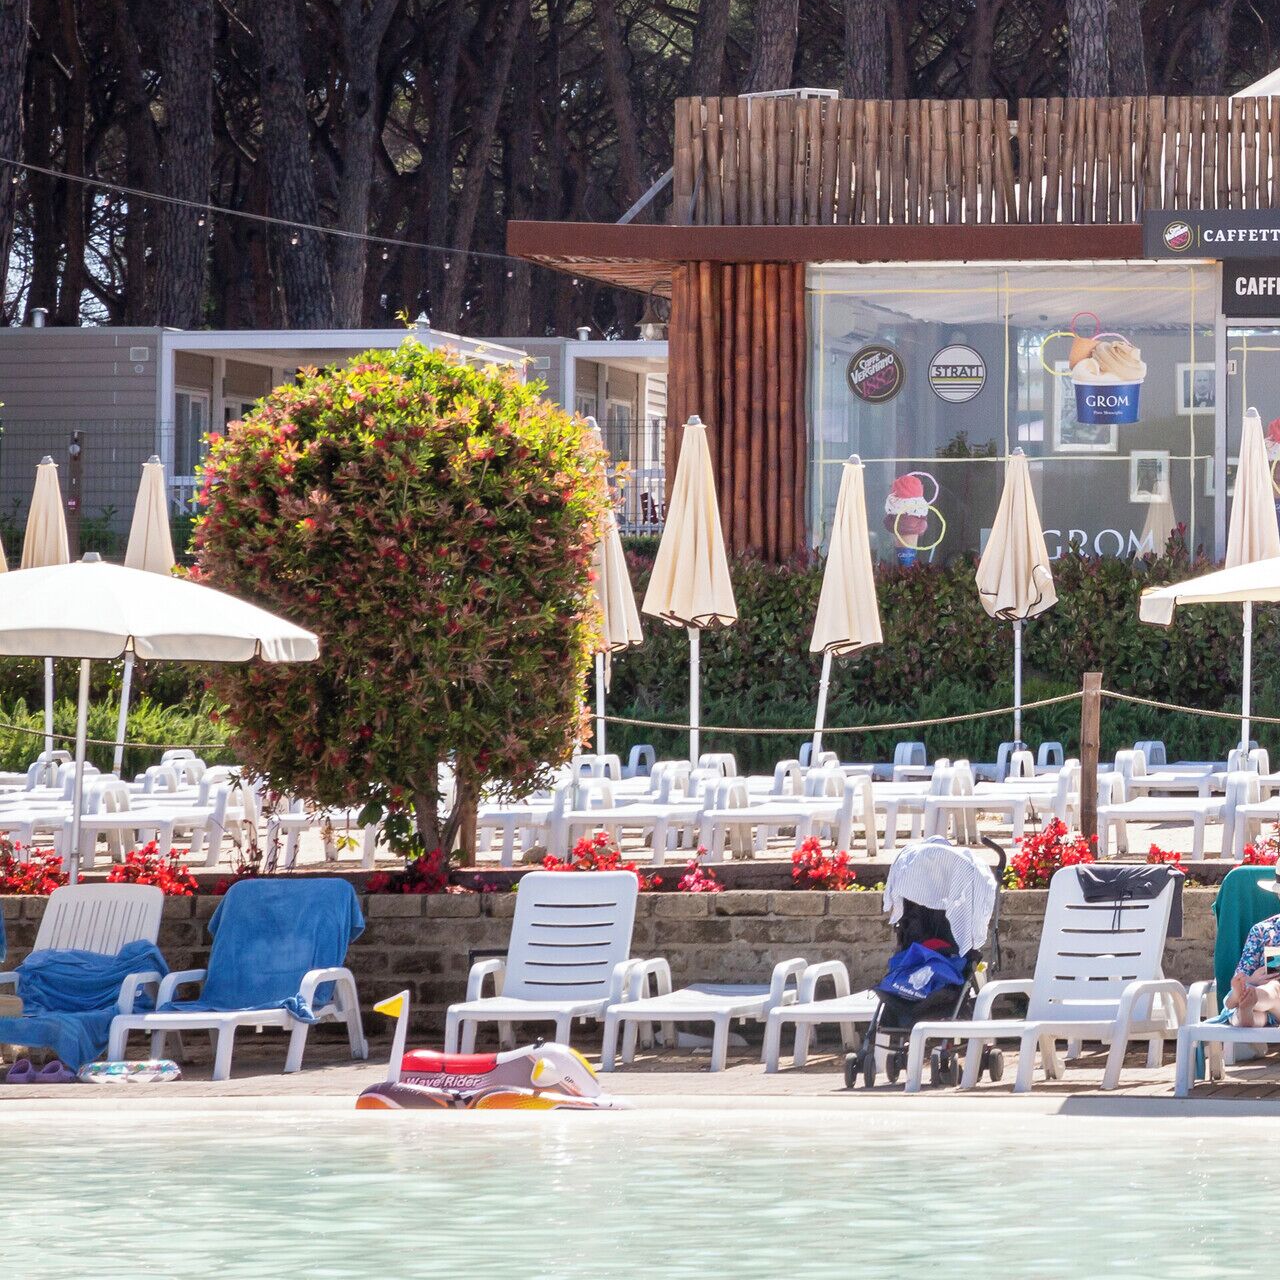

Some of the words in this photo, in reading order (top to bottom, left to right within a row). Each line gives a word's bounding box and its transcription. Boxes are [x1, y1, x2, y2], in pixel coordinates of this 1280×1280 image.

[933, 365, 981, 378] STRATI
[1085, 395, 1130, 408] GROM
[406, 1077, 440, 1087] Wave
[443, 1076, 481, 1087] Rider
